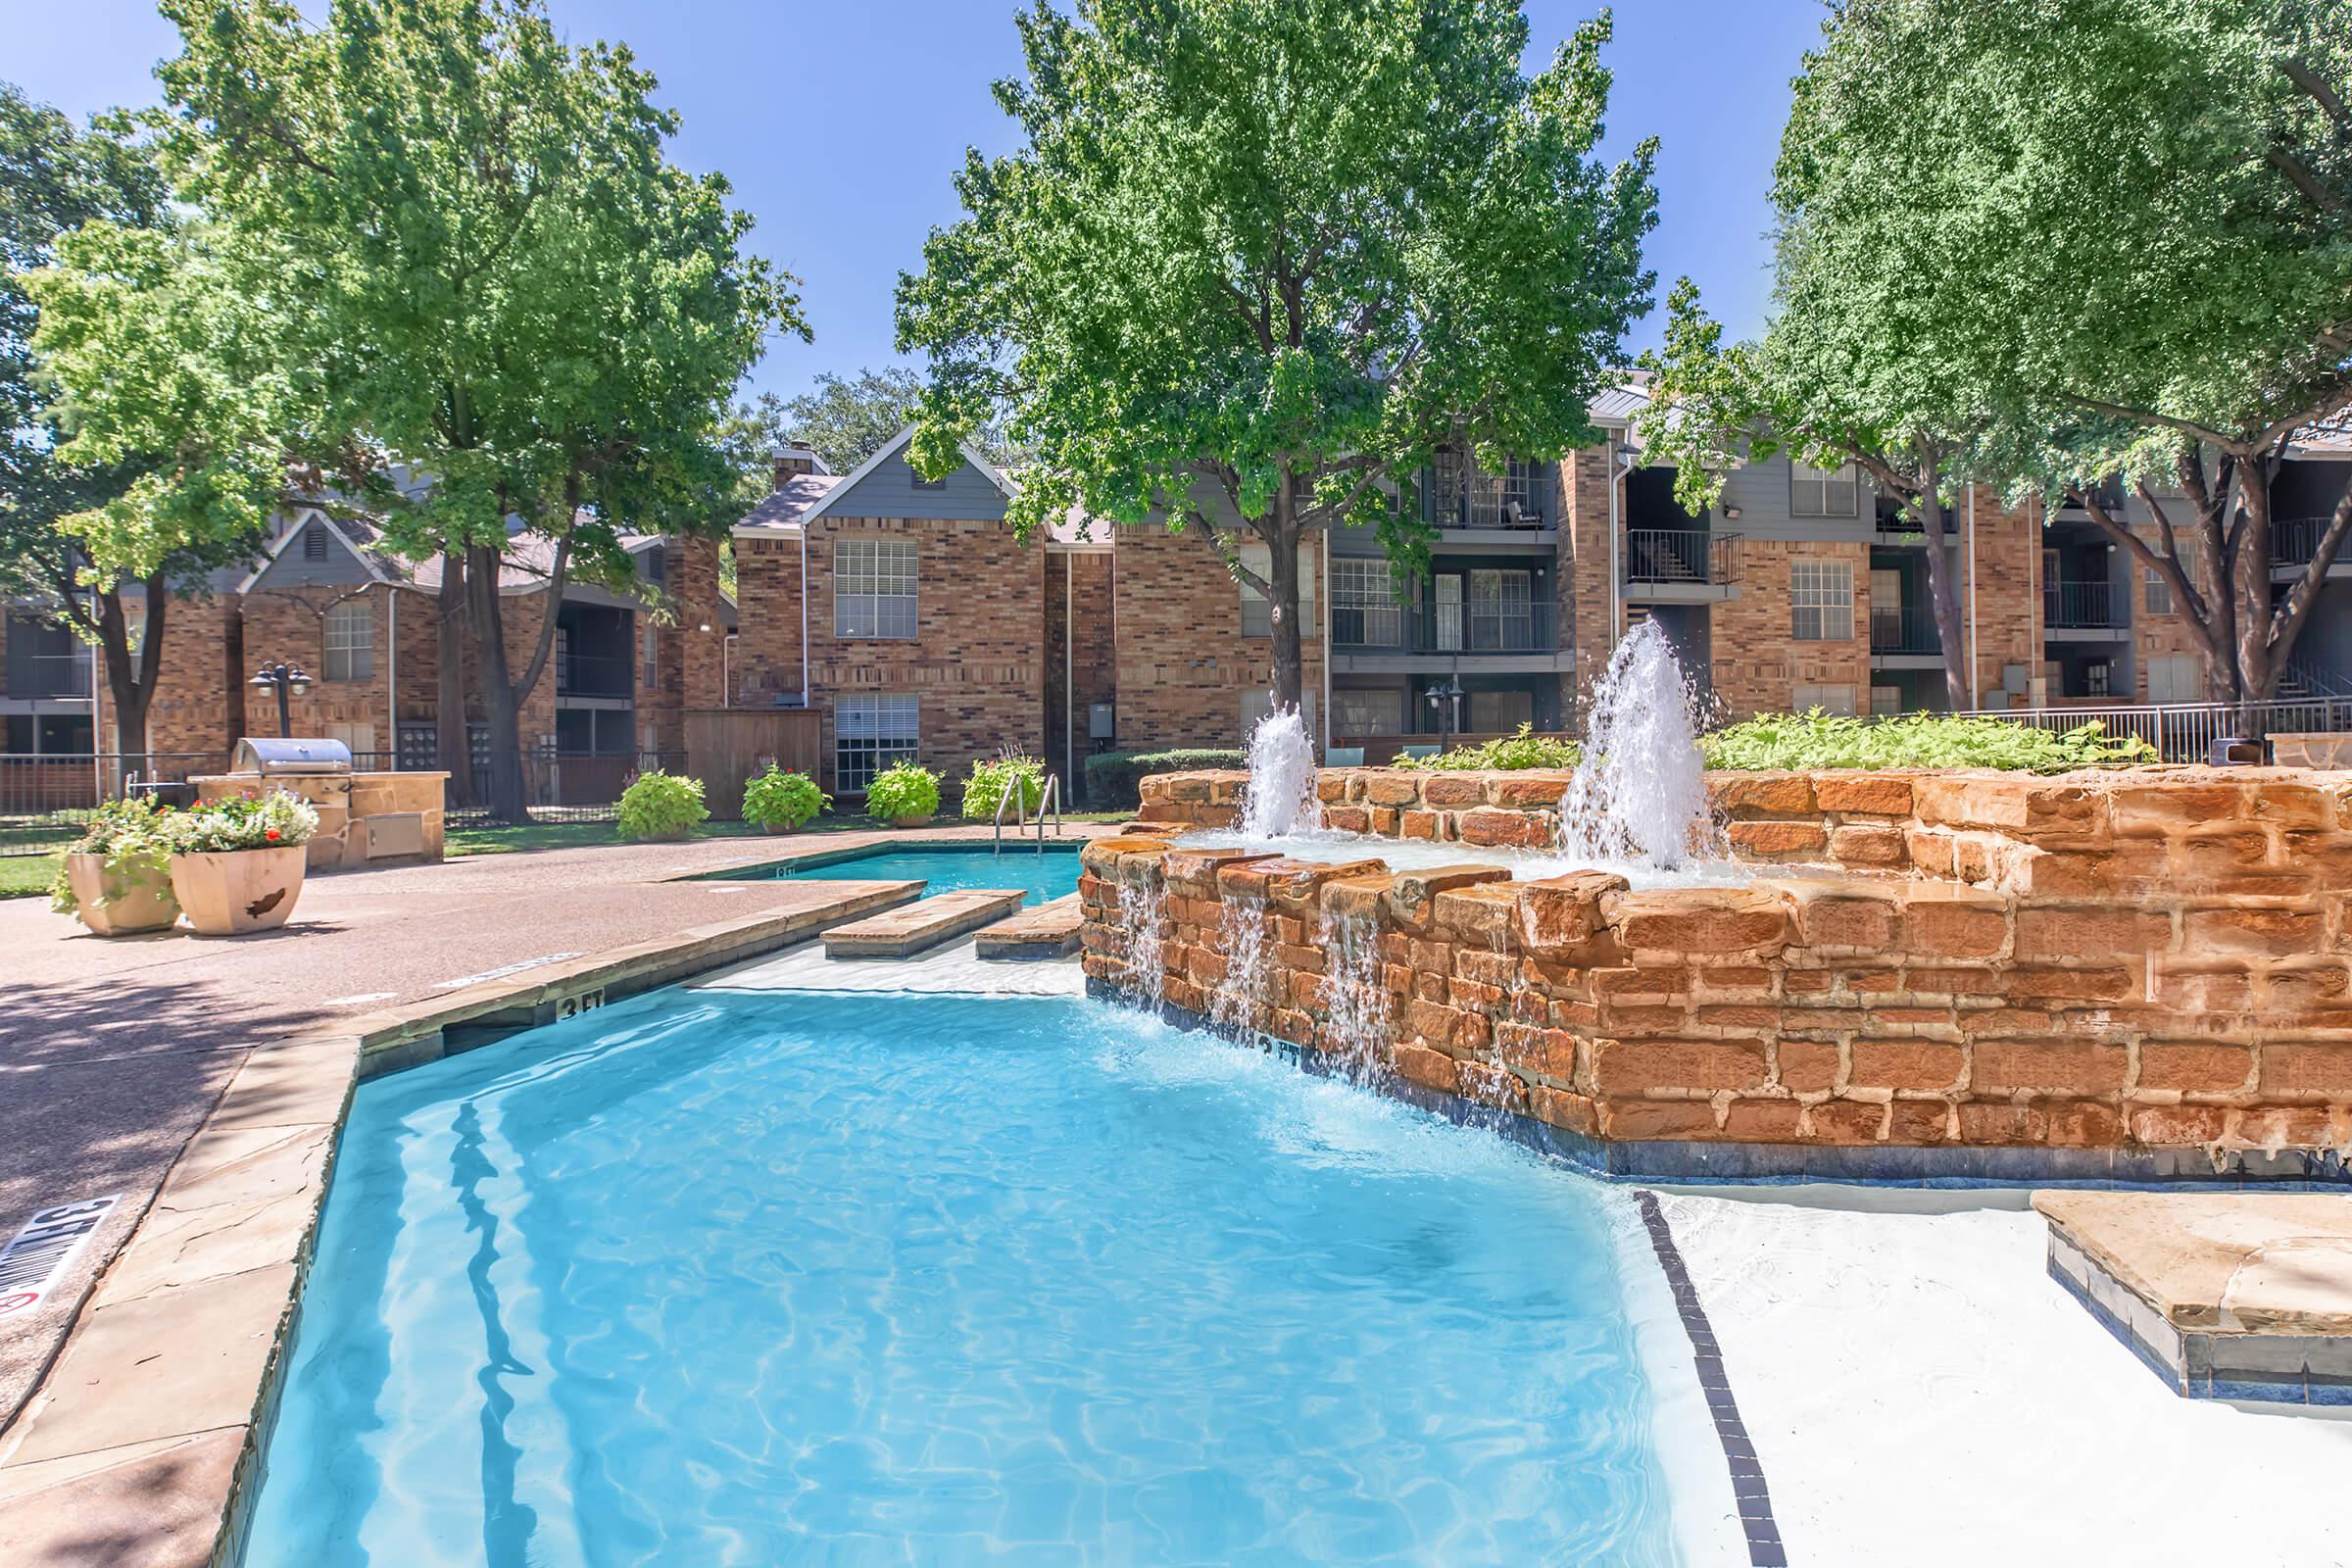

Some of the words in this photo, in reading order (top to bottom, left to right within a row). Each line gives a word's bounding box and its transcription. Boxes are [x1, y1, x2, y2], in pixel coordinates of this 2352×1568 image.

[582, 989, 604, 1013] FT
[1278, 1041, 1300, 1066] FT
[33, 1199, 114, 1224] 3
